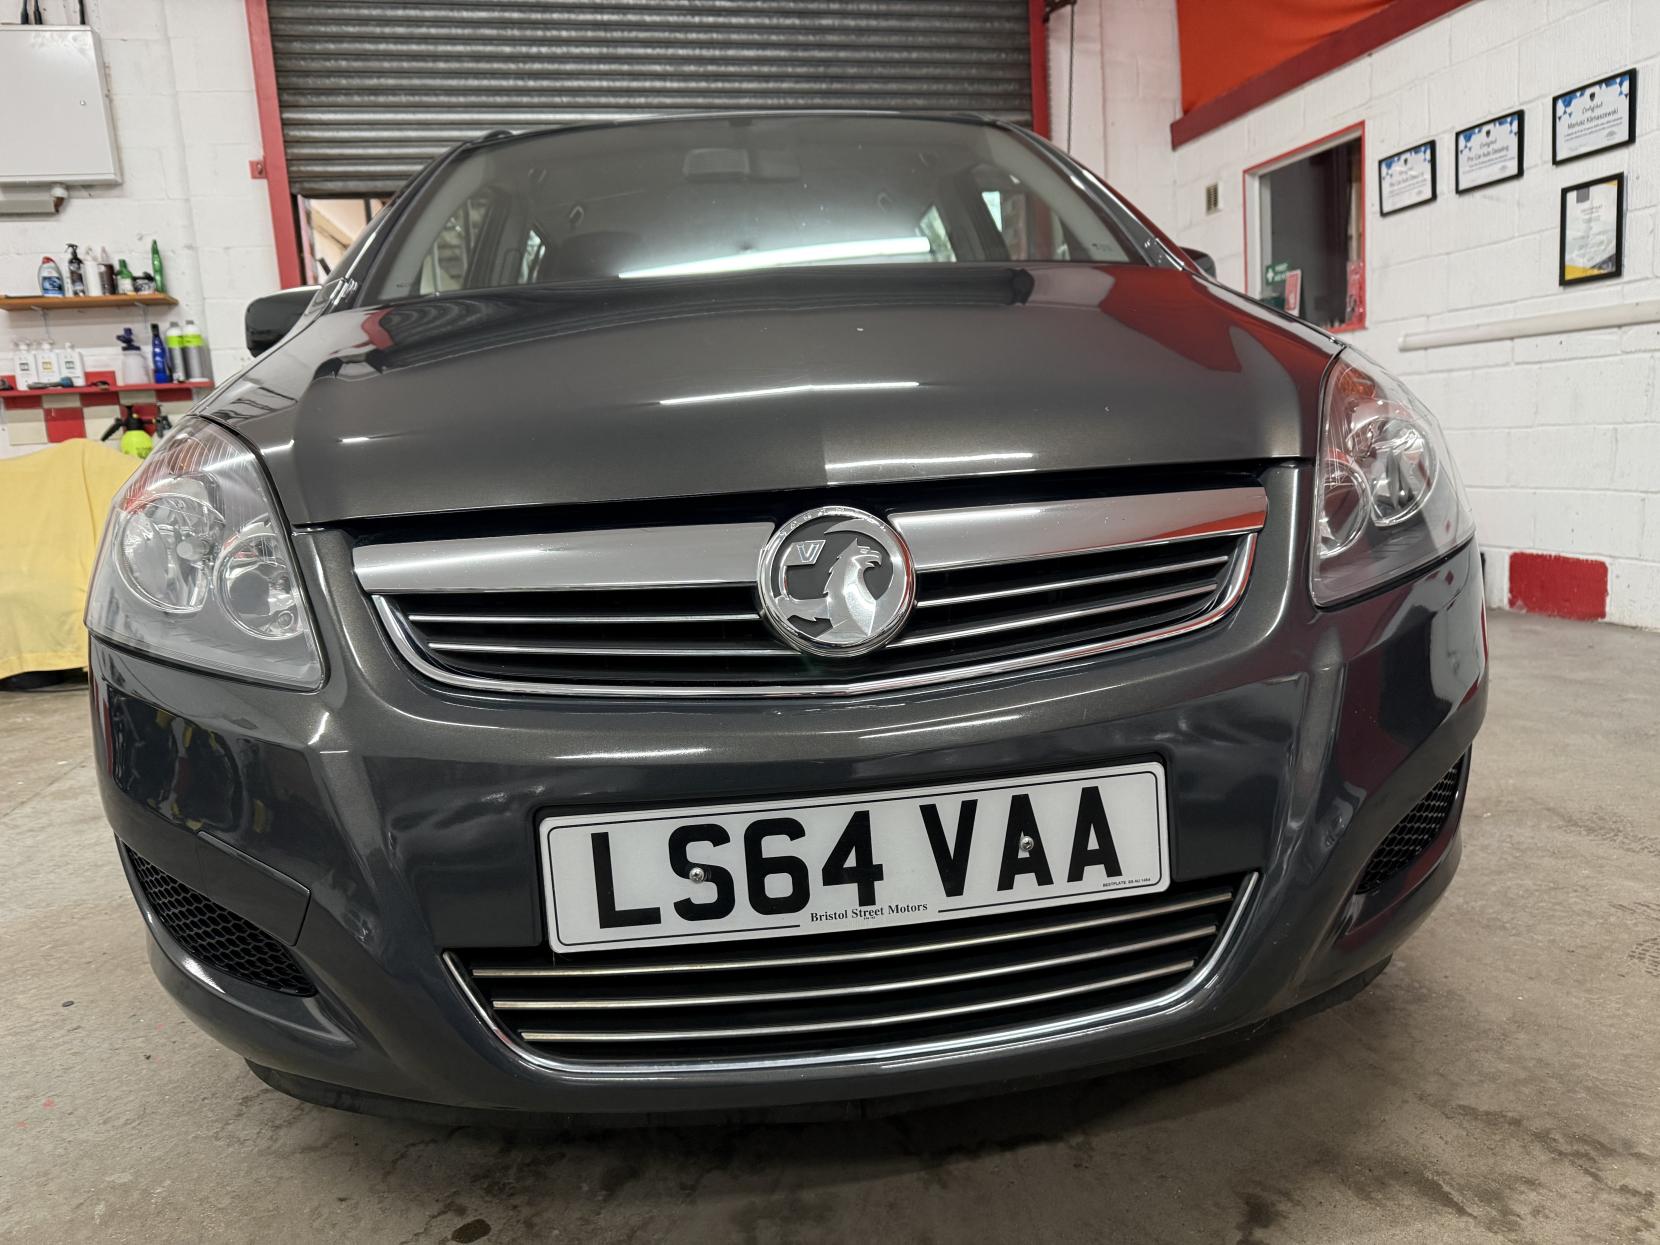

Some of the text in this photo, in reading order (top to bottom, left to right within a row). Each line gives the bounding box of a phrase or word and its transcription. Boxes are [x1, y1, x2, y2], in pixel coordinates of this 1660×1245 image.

[591, 786, 1122, 928] LS64 VAA
[810, 902, 928, 922] Bristol Street Motors
